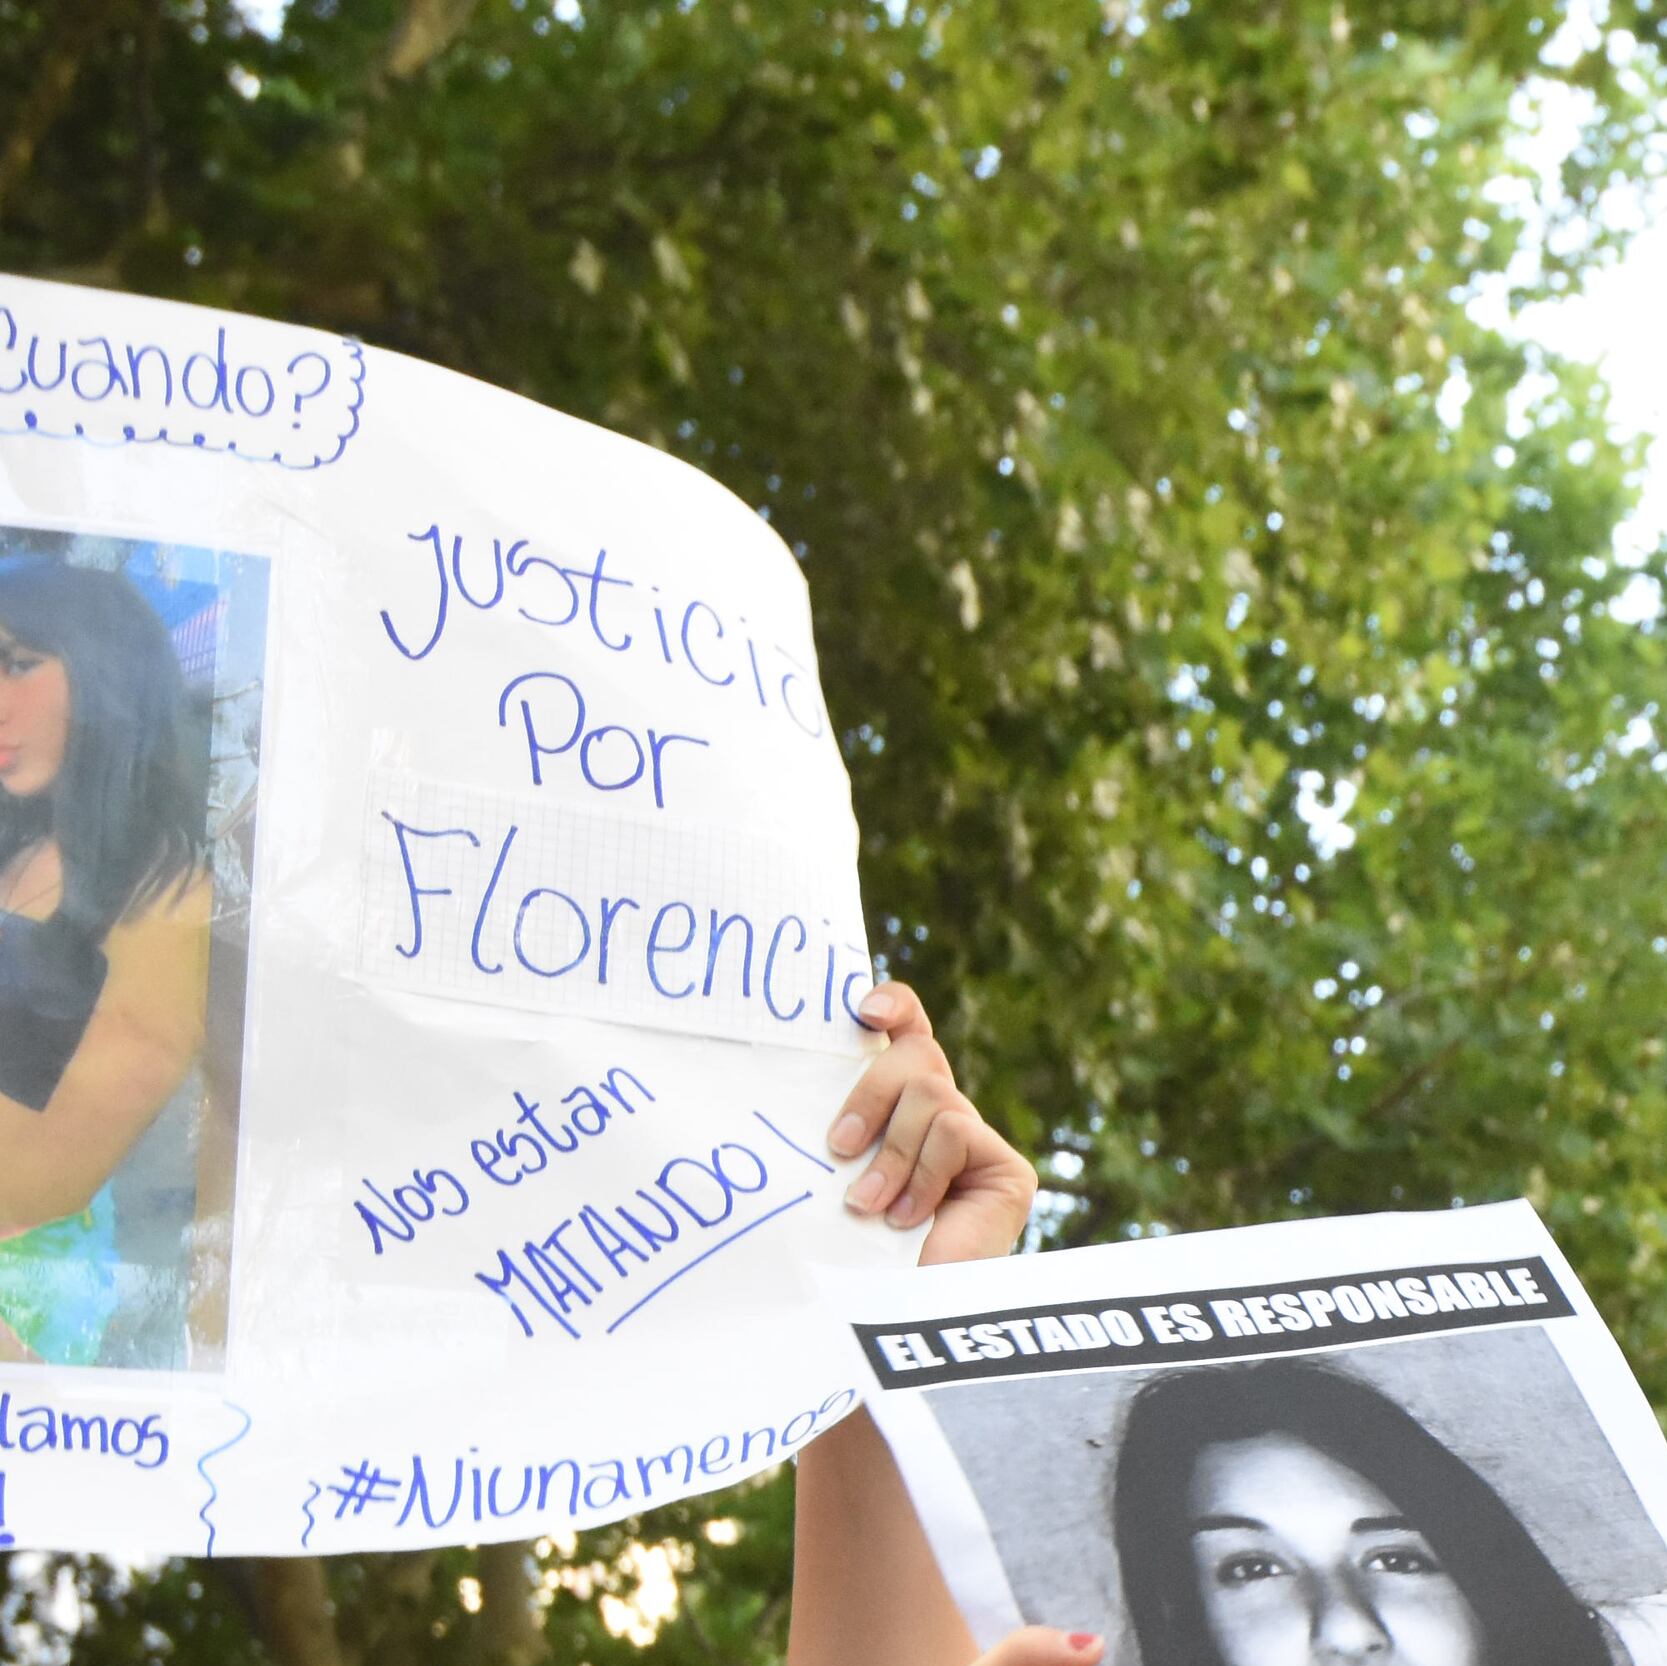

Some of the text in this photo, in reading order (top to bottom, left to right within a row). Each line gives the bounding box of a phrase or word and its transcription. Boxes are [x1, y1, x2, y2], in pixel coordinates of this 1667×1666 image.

[499, 671, 710, 808] Por
[470, 1062, 656, 1186] estan
[875, 1268, 1547, 1373] EL ESTADO ES RESPONSABLE
